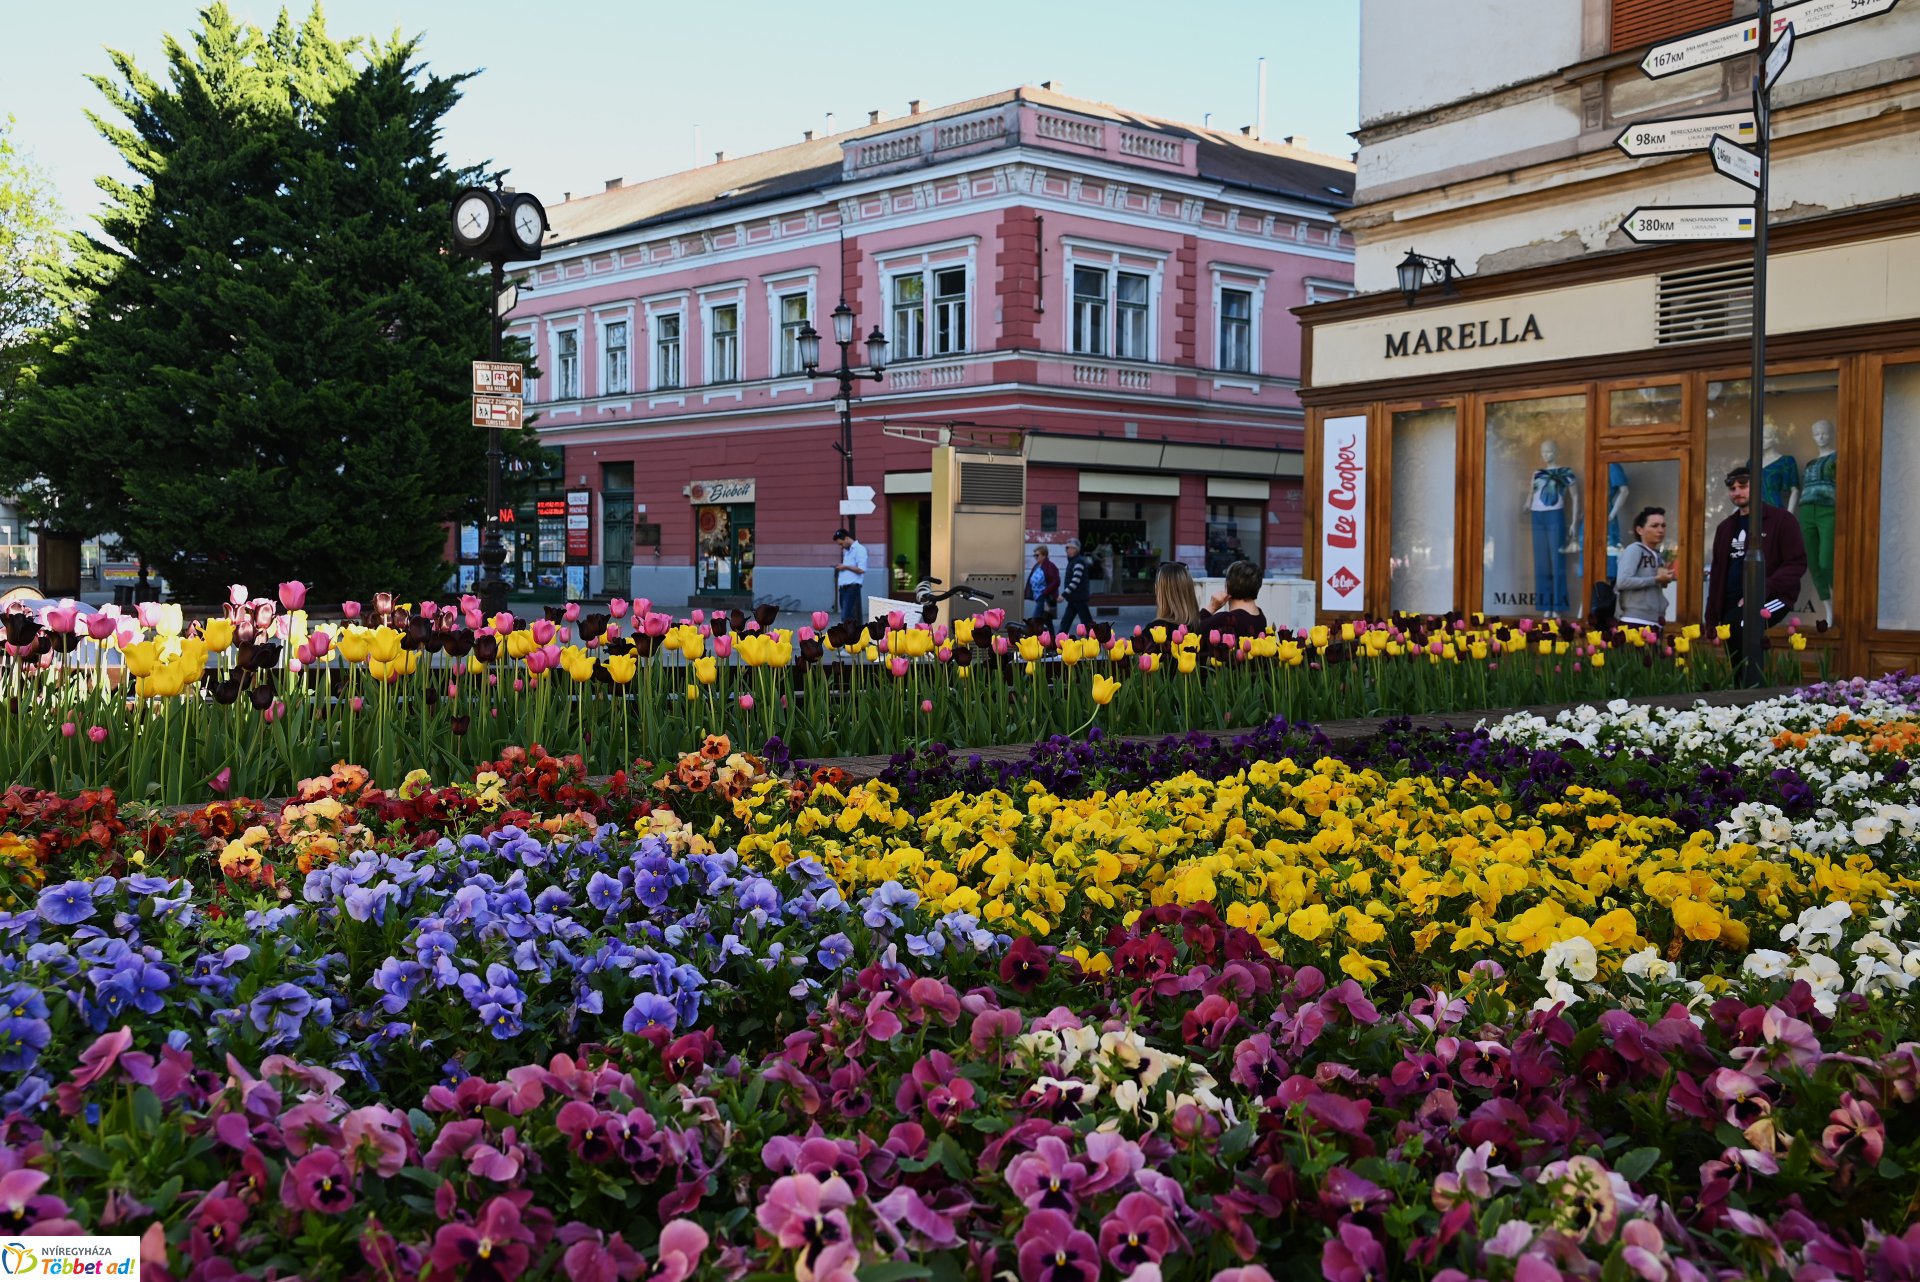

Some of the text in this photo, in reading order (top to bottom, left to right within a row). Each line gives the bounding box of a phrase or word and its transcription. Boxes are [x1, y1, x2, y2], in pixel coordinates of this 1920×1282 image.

[1636, 133, 1666, 146] 98KM
[1638, 219, 1675, 232] 380KM
[1384, 313, 1544, 359] MARELLA
[1328, 434, 1364, 511] Cooper
[1327, 514, 1357, 549] Lee
[1493, 591, 1570, 607] MARELLA
